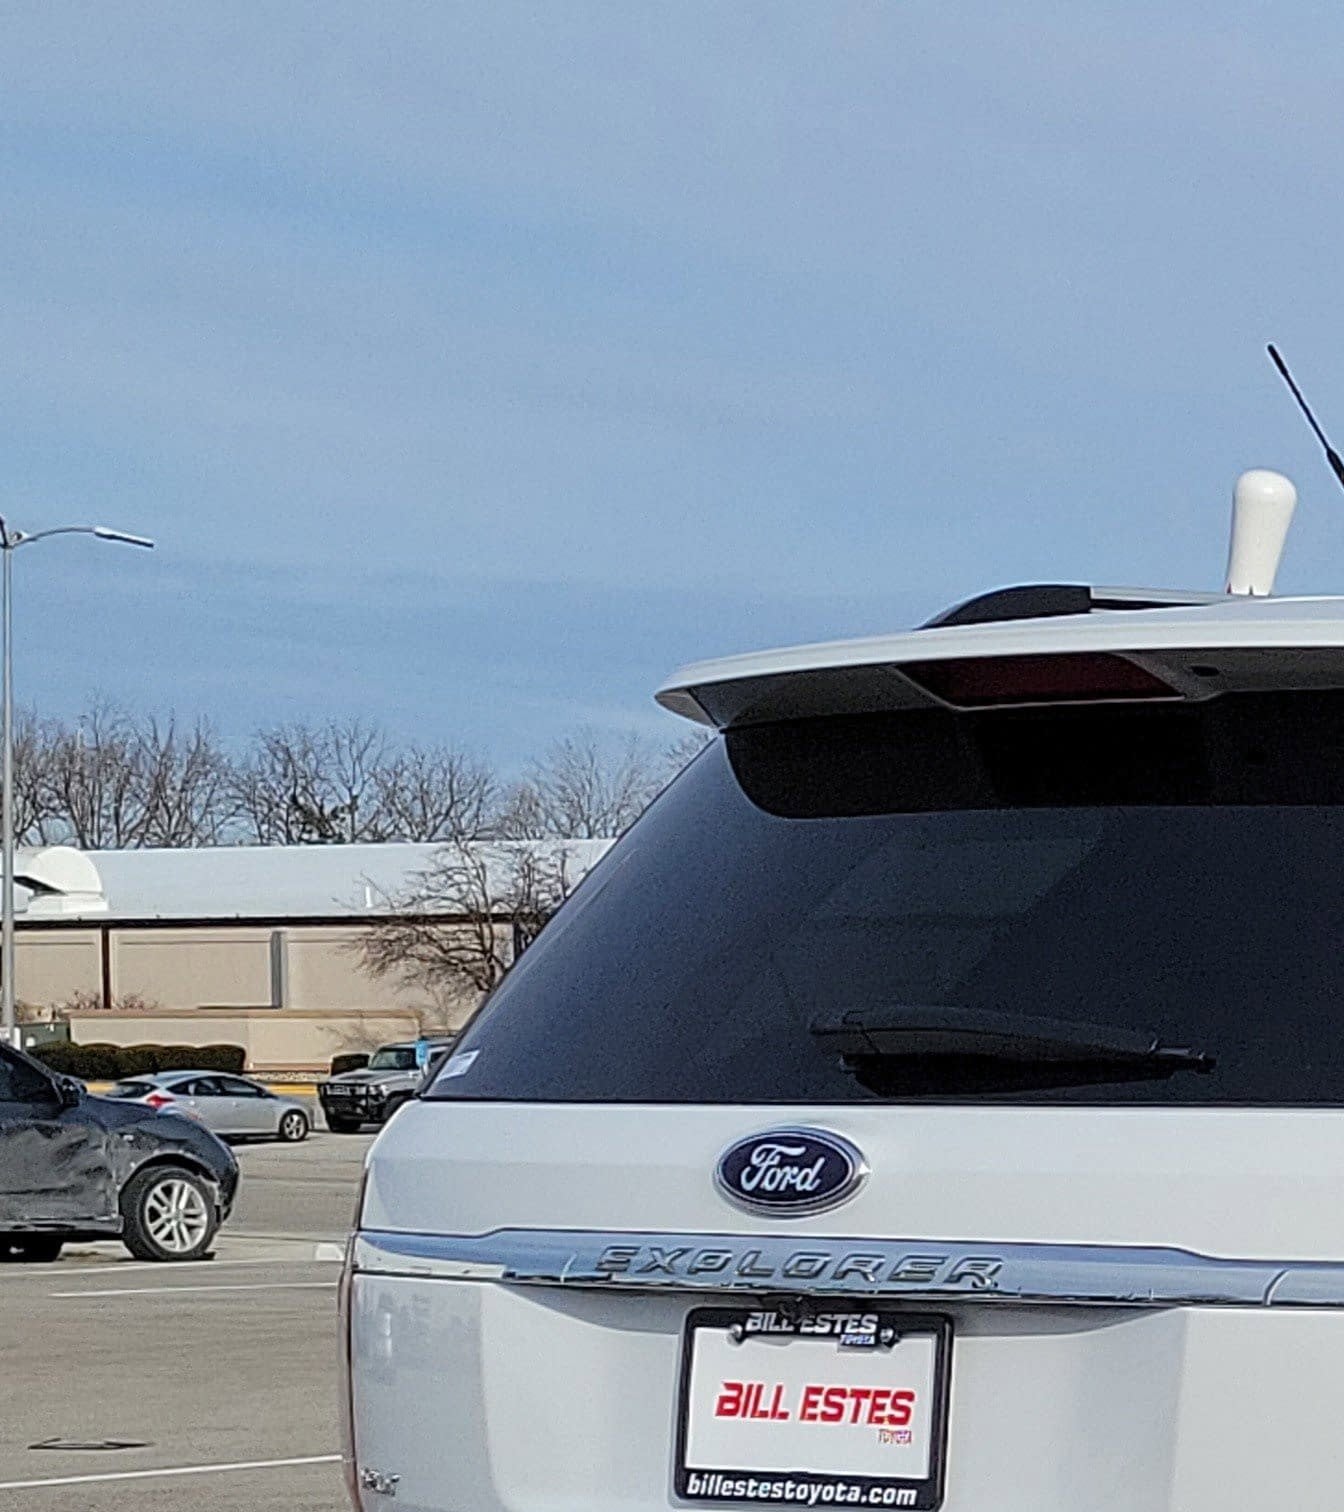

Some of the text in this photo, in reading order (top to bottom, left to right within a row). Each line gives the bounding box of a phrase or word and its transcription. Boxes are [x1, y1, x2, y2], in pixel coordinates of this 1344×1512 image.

[741, 1143, 826, 1192] Ford
[596, 1245, 1004, 1288] EXPLORER
[745, 1312, 878, 1333] BILL ESTES
[715, 1382, 915, 1425] BILL ESTES
[687, 1474, 917, 1506] billestestoyota.com
